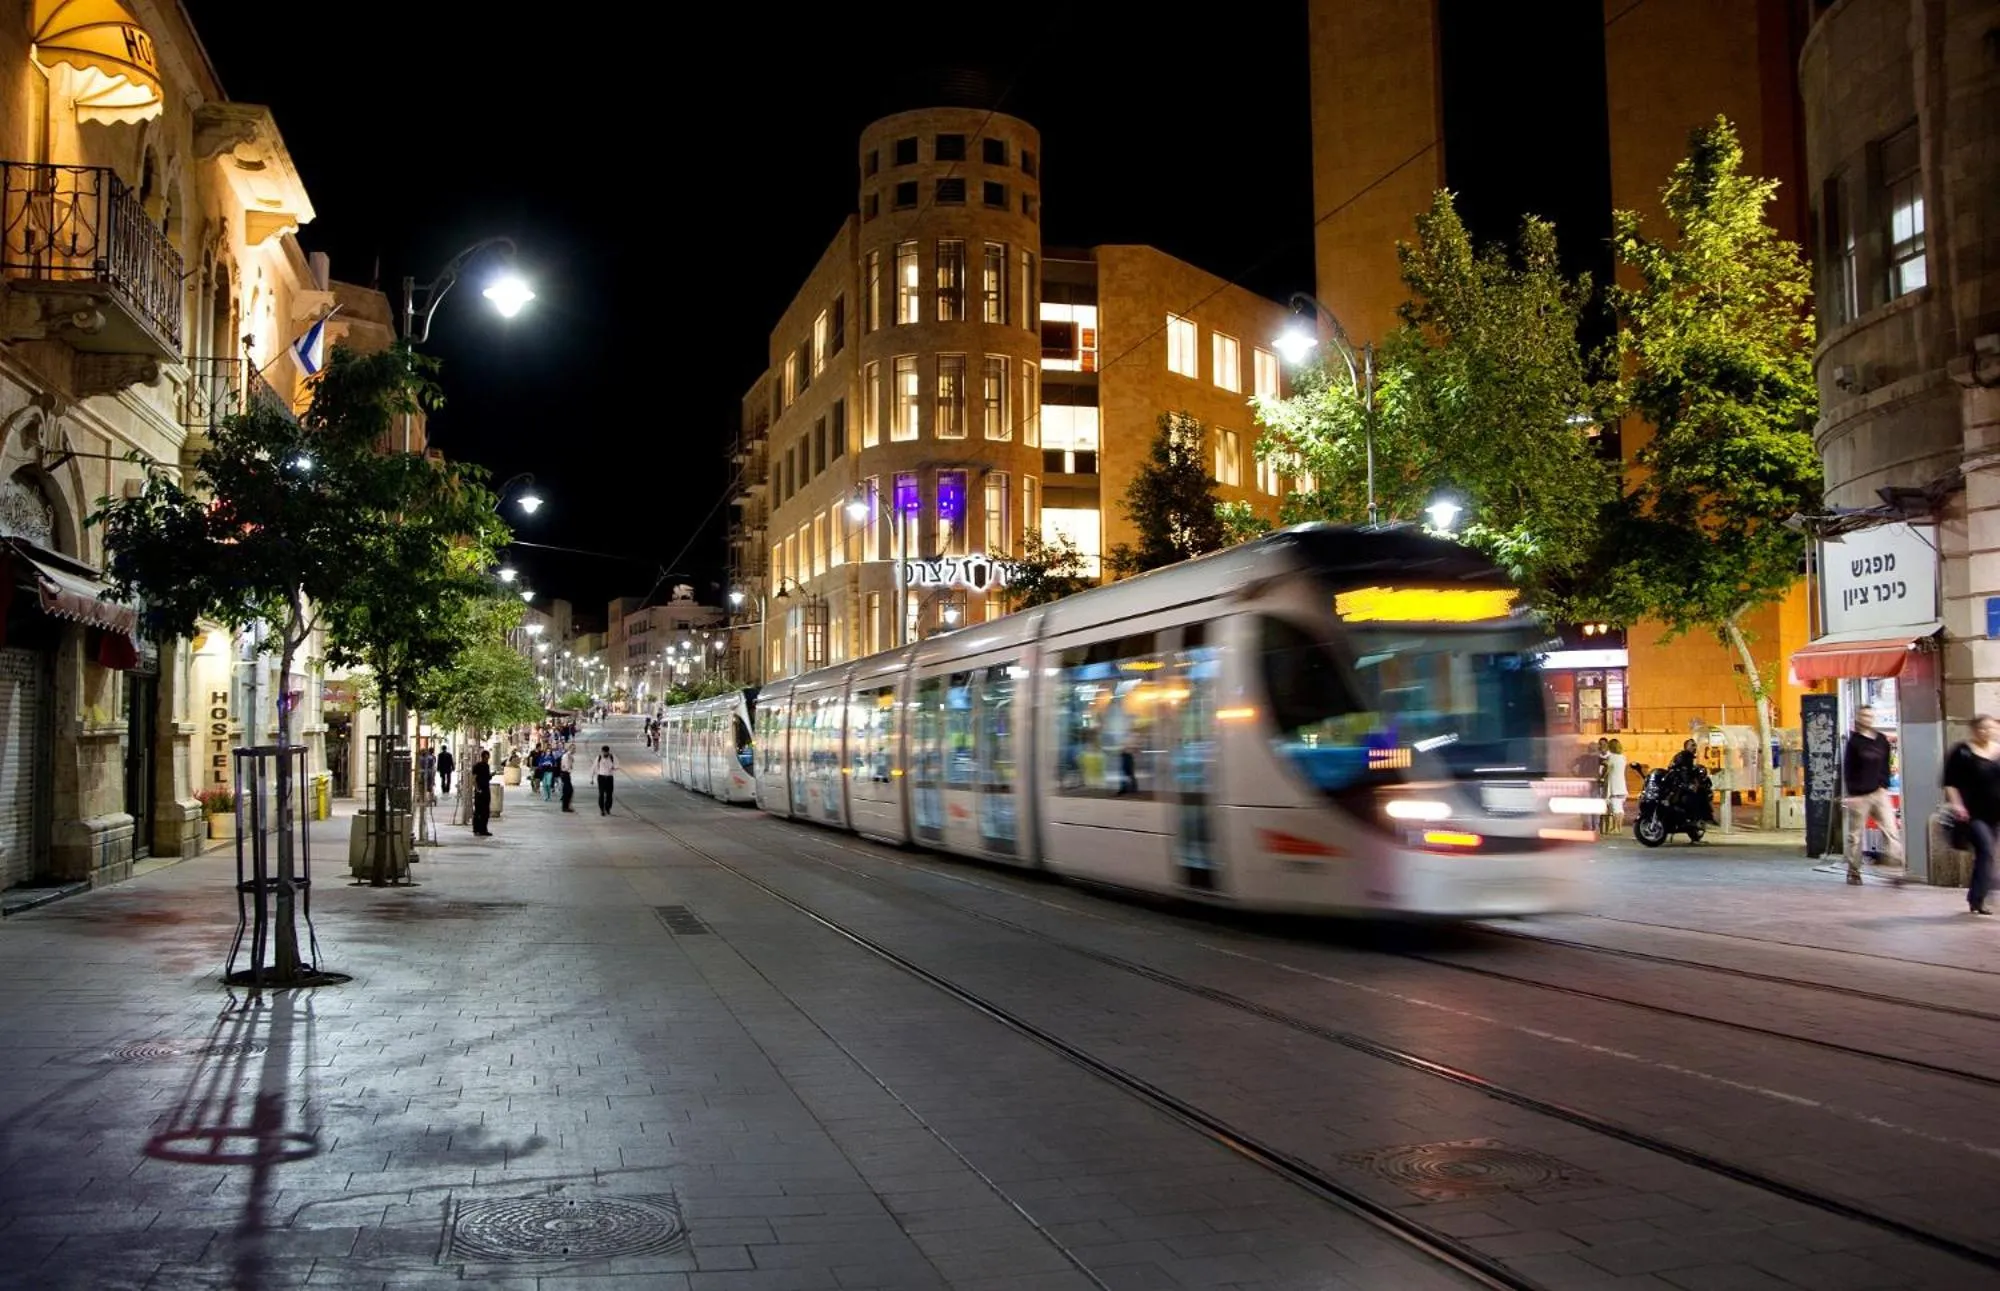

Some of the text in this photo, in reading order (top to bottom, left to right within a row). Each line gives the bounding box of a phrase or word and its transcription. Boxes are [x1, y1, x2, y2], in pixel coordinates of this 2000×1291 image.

[1851, 553, 1895, 577] מפגש
[1843, 581, 1906, 611] כיכר ציון
[211, 692, 228, 783] HOSTEL
